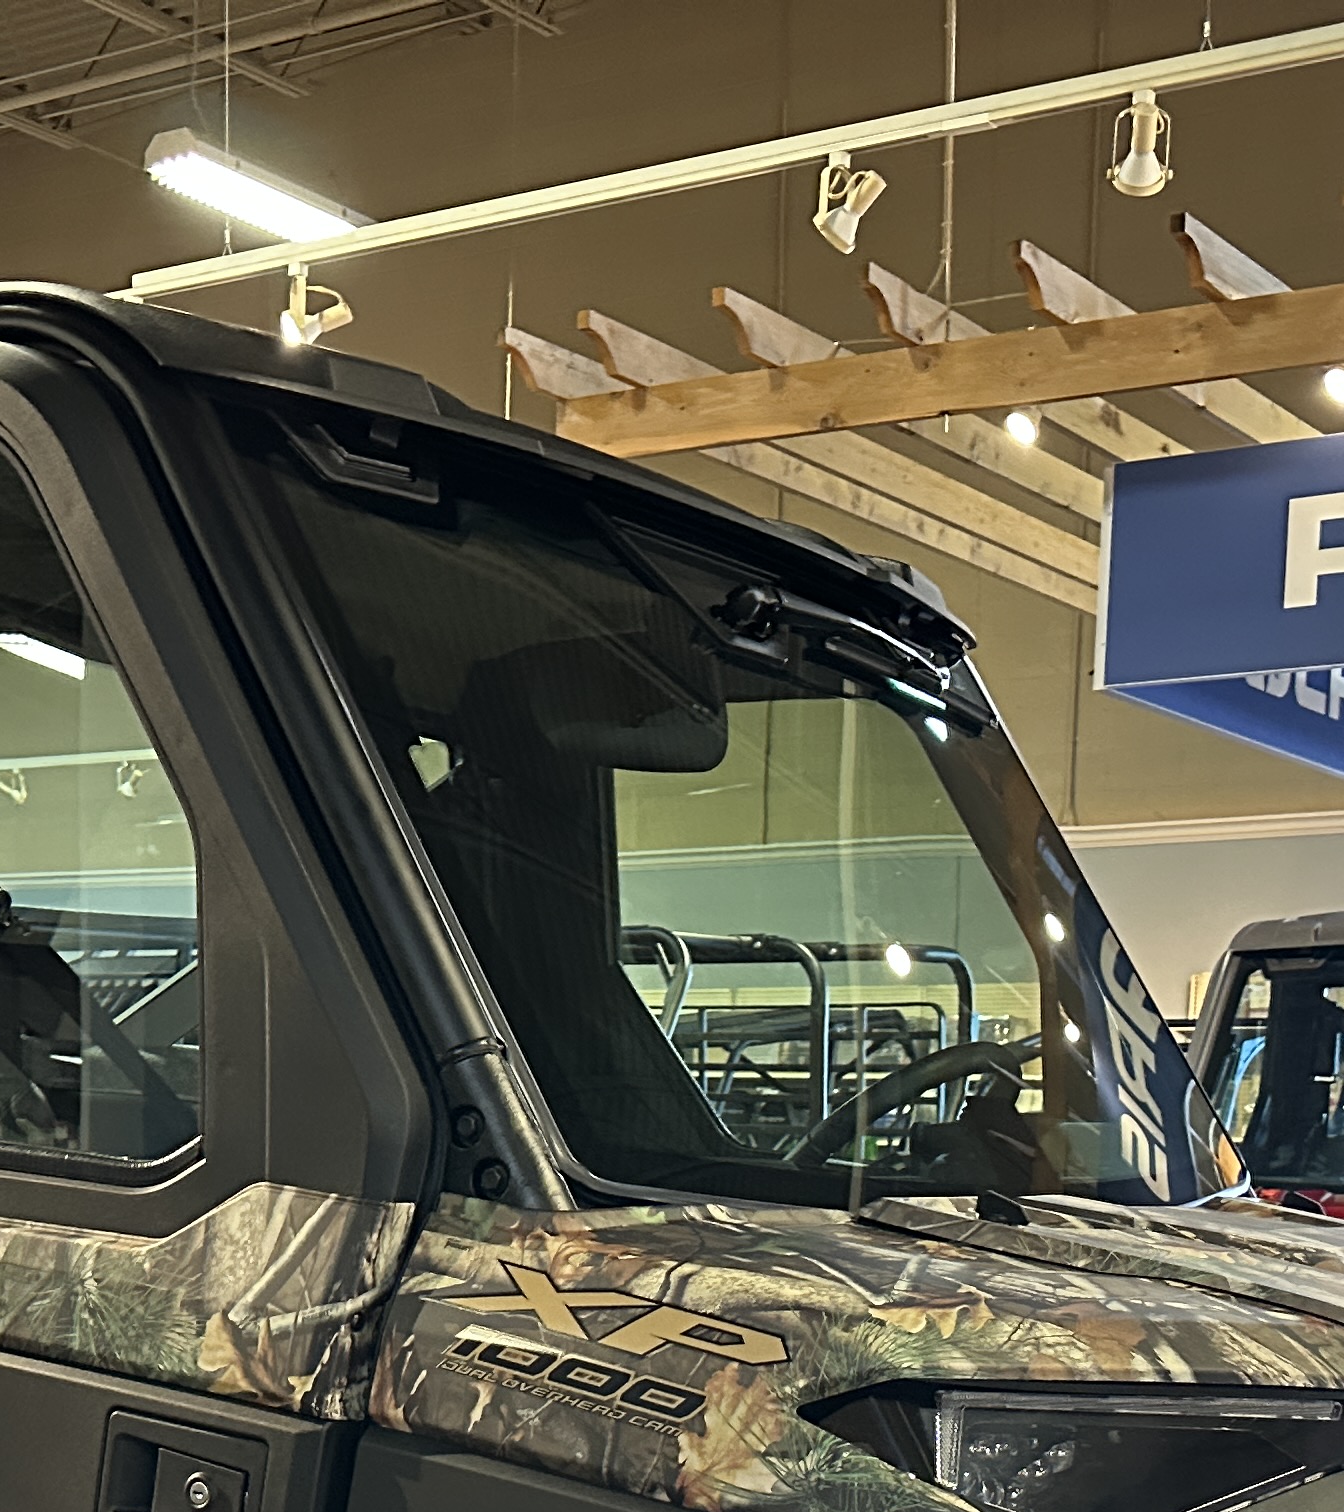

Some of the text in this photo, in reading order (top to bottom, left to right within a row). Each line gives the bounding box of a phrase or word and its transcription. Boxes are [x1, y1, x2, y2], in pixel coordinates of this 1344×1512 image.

[420, 1259, 792, 1366] XP
[436, 1357, 683, 1438] DUAL OVERHEAD CAM
[441, 1326, 707, 1423] 1000
